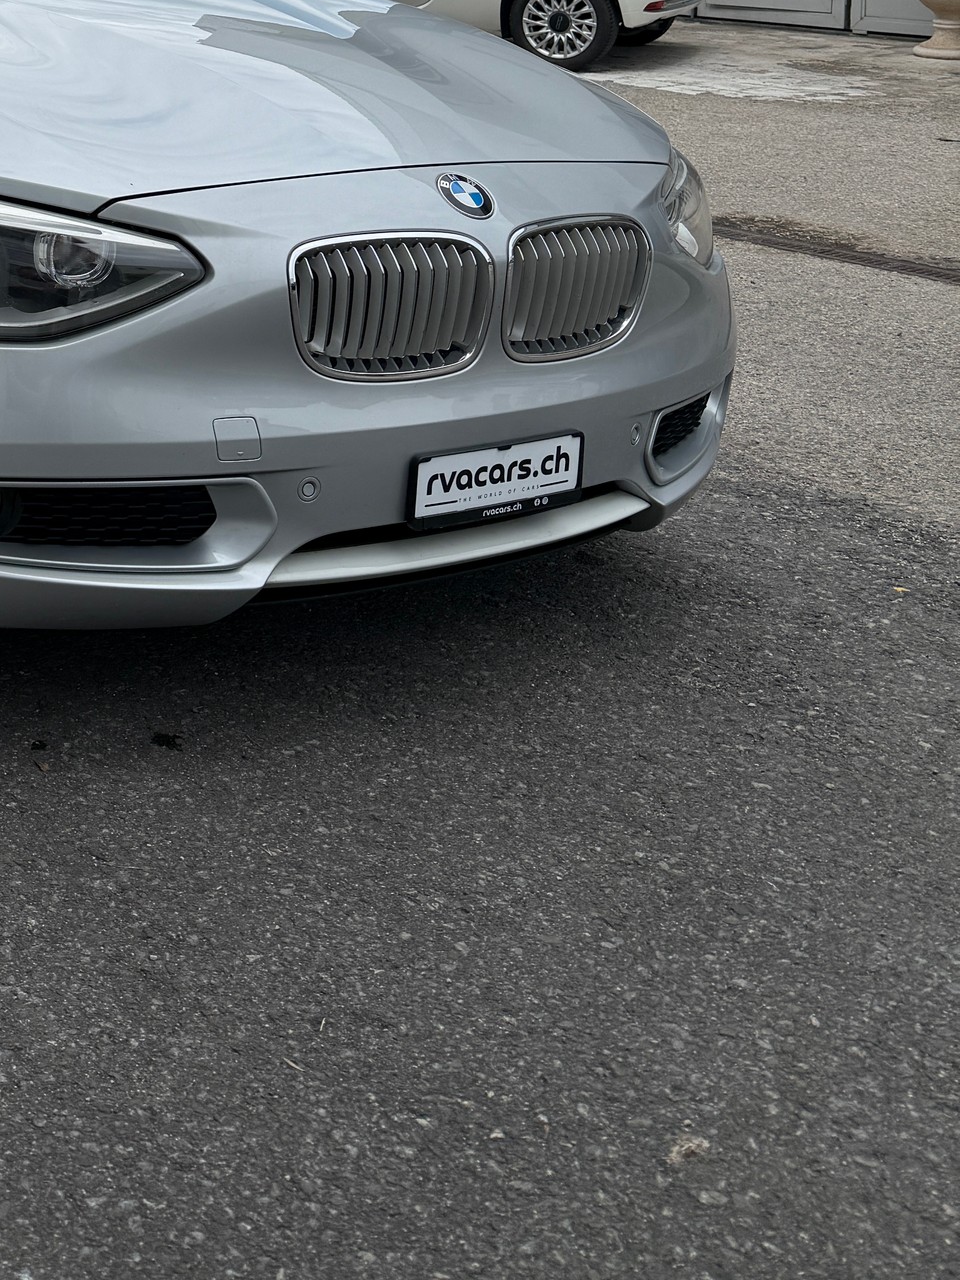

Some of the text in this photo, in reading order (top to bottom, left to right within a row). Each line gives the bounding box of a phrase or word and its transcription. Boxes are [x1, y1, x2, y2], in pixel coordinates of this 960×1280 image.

[426, 445, 570, 496] rvacars.ch
[478, 490, 502, 500] WORLD
[522, 484, 540, 492] CARS
[482, 502, 522, 517] rvacars.ch
